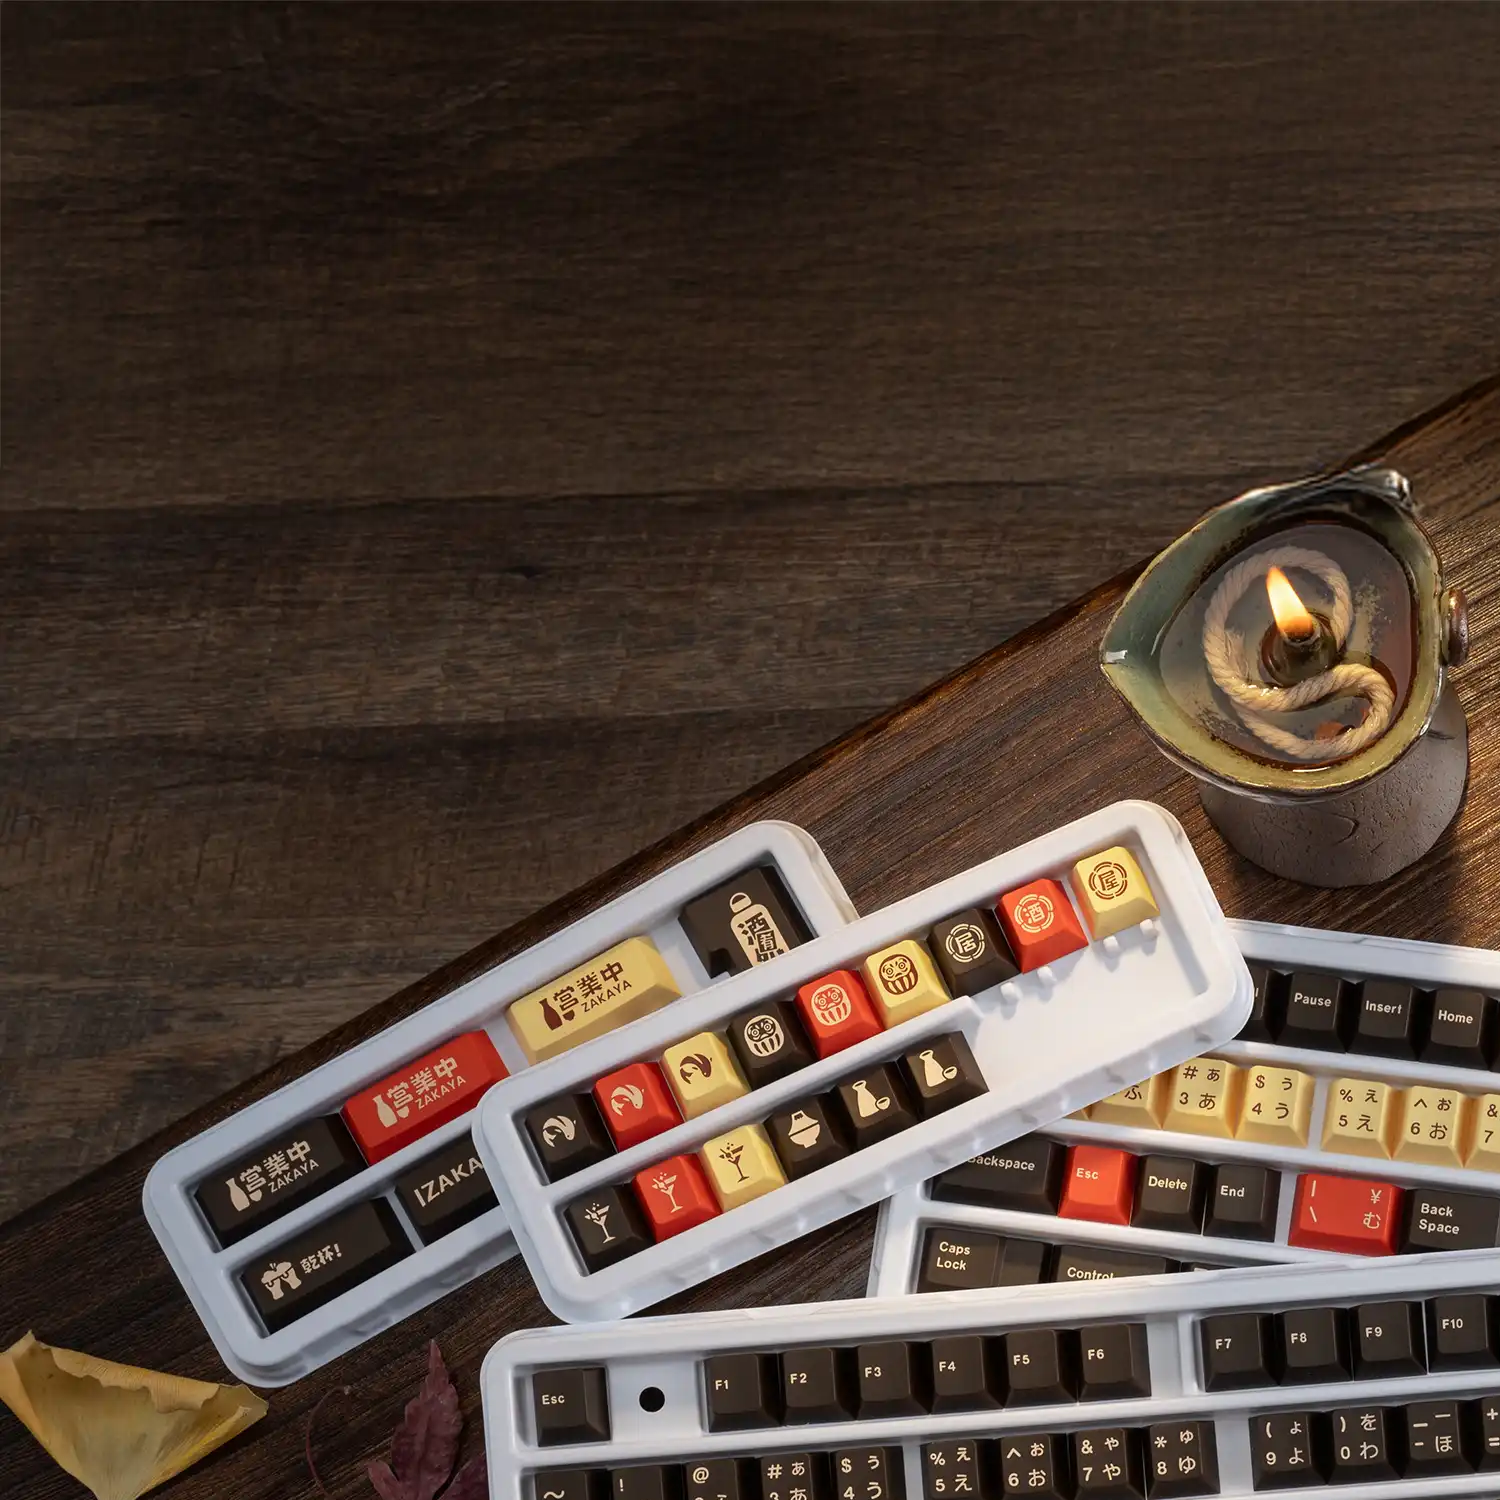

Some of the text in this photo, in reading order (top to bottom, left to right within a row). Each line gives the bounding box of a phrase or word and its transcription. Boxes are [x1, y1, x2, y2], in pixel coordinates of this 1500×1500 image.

[581, 980, 632, 1012] ZAKAYA
[1294, 992, 1331, 1007] Pause
[1366, 1000, 1402, 1014] Insert
[1438, 1010, 1473, 1024] Home
[415, 1076, 466, 1110] ZAKAYA
[1179, 1092, 1189, 1105] 3
[1252, 1103, 1262, 1115] 4
[1339, 1115, 1348, 1127] 5
[1411, 1122, 1420, 1135] 6
[1485, 1130, 1494, 1143] 7
[267, 1158, 320, 1193] ZAKAYA
[1076, 1168, 1098, 1179] Esc
[1148, 1176, 1187, 1190] Delete
[1220, 1185, 1245, 1197] End
[1421, 1203, 1453, 1217] Back
[1419, 1219, 1459, 1234] Space
[939, 1241, 970, 1255] Caps
[937, 1257, 966, 1270] Lock
[1442, 1318, 1463, 1329] F10
[1291, 1332, 1307, 1344] F8
[1366, 1327, 1382, 1337] F9
[1215, 1338, 1231, 1349] F7
[1013, 1354, 1030, 1365] F5
[1088, 1349, 1104, 1360] F6
[865, 1367, 881, 1378] F3
[939, 1361, 956, 1372] F4
[715, 1380, 728, 1390] F1
[790, 1373, 807, 1384] F2
[542, 1394, 565, 1405] Esc
[1266, 1452, 1276, 1465] 9
[1083, 1467, 1093, 1481] 7
[1157, 1461, 1167, 1475] 8
[936, 1479, 945, 1492] 5
[1008, 1473, 1019, 1487] 6
[843, 1486, 855, 1500] 4
